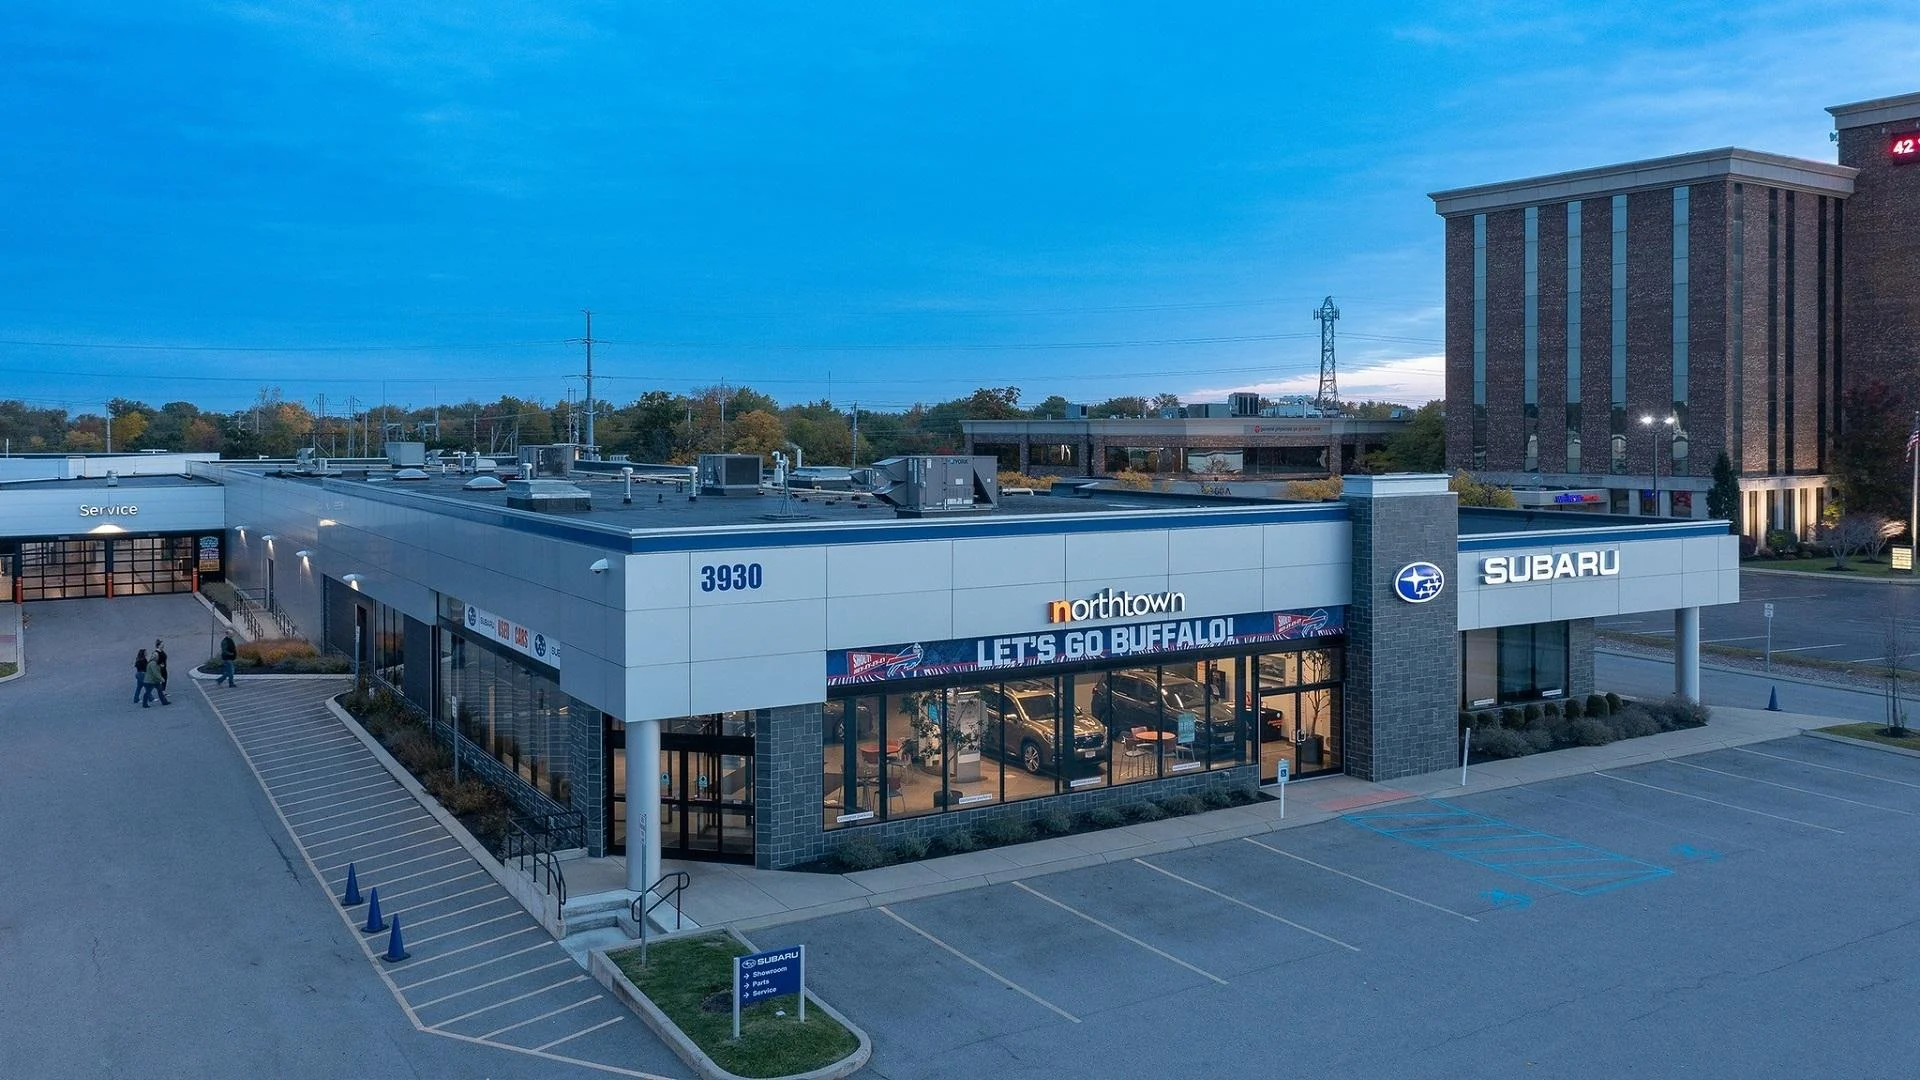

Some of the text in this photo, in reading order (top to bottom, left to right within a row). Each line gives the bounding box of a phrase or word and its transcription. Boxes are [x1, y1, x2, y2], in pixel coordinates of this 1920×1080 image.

[1893, 139, 1915, 154] 42
[79, 504, 138, 517] Service
[1483, 550, 1620, 585] SUBARU
[701, 563, 762, 592] 3930
[1050, 588, 1186, 624] northtown
[515, 626, 529, 649] CARS
[977, 618, 1234, 667] LET'S GO BUFFALO!
[757, 951, 799, 965] SUBARU
[753, 966, 788, 978] Showroom
[752, 979, 770, 987] Parts
[753, 987, 777, 997] Service
